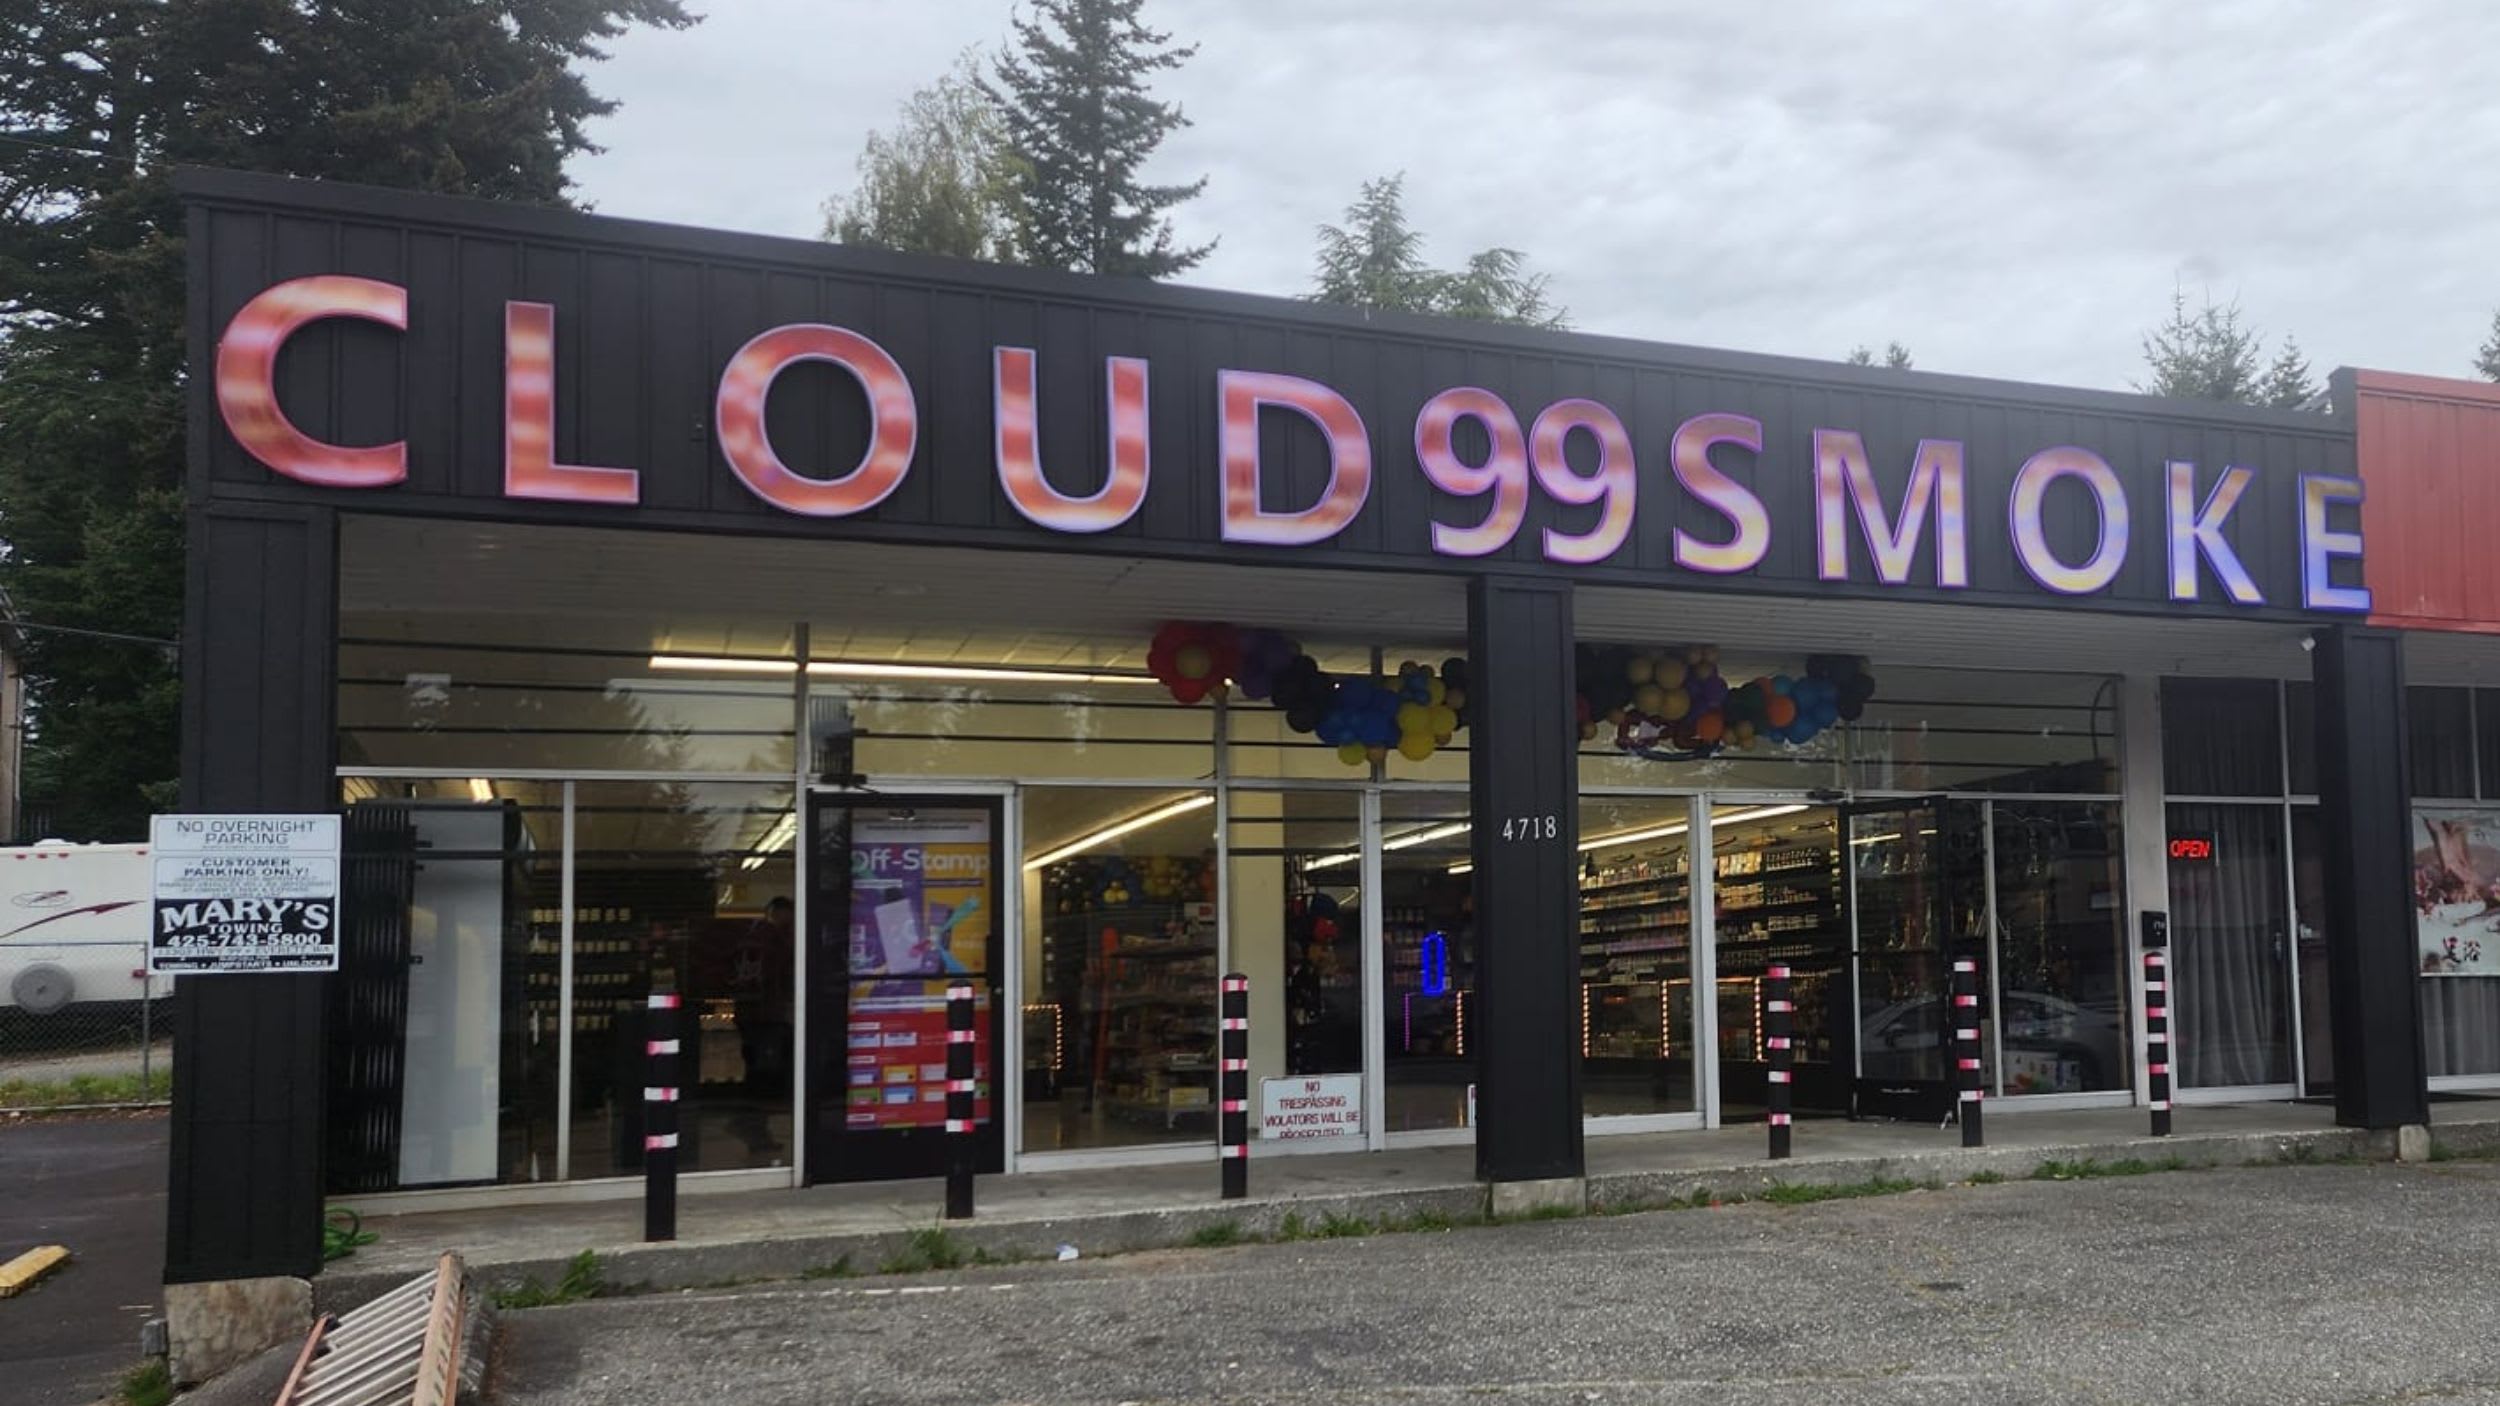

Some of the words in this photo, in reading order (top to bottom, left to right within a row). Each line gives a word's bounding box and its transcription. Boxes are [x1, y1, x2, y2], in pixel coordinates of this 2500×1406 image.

[216, 275, 1372, 545] CLOUD
[1414, 386, 1637, 564] 99
[1671, 412, 2372, 611] SMOKE
[177, 820, 204, 833] NO
[211, 820, 316, 833] OVERNIGHT
[1502, 815, 1557, 841] 4718
[205, 833, 289, 845] PARKING
[2169, 839, 2211, 858] OPEN
[201, 857, 291, 867] CUSTOMER
[850, 848, 990, 875] Off-Stamp
[184, 868, 256, 877] PARKING
[261, 867, 310, 877] ONLY!
[160, 898, 330, 933] MARY'S
[208, 922, 283, 934] TOWING
[166, 933, 322, 947] 425-743-5800
[1304, 1081, 1320, 1093] NO
[1278, 1096, 1347, 1110] TRESPASSING
[1264, 1112, 1320, 1127] VIOLATORS
[1320, 1112, 1343, 1124] WILL
[1346, 1110, 1360, 1122] BE
